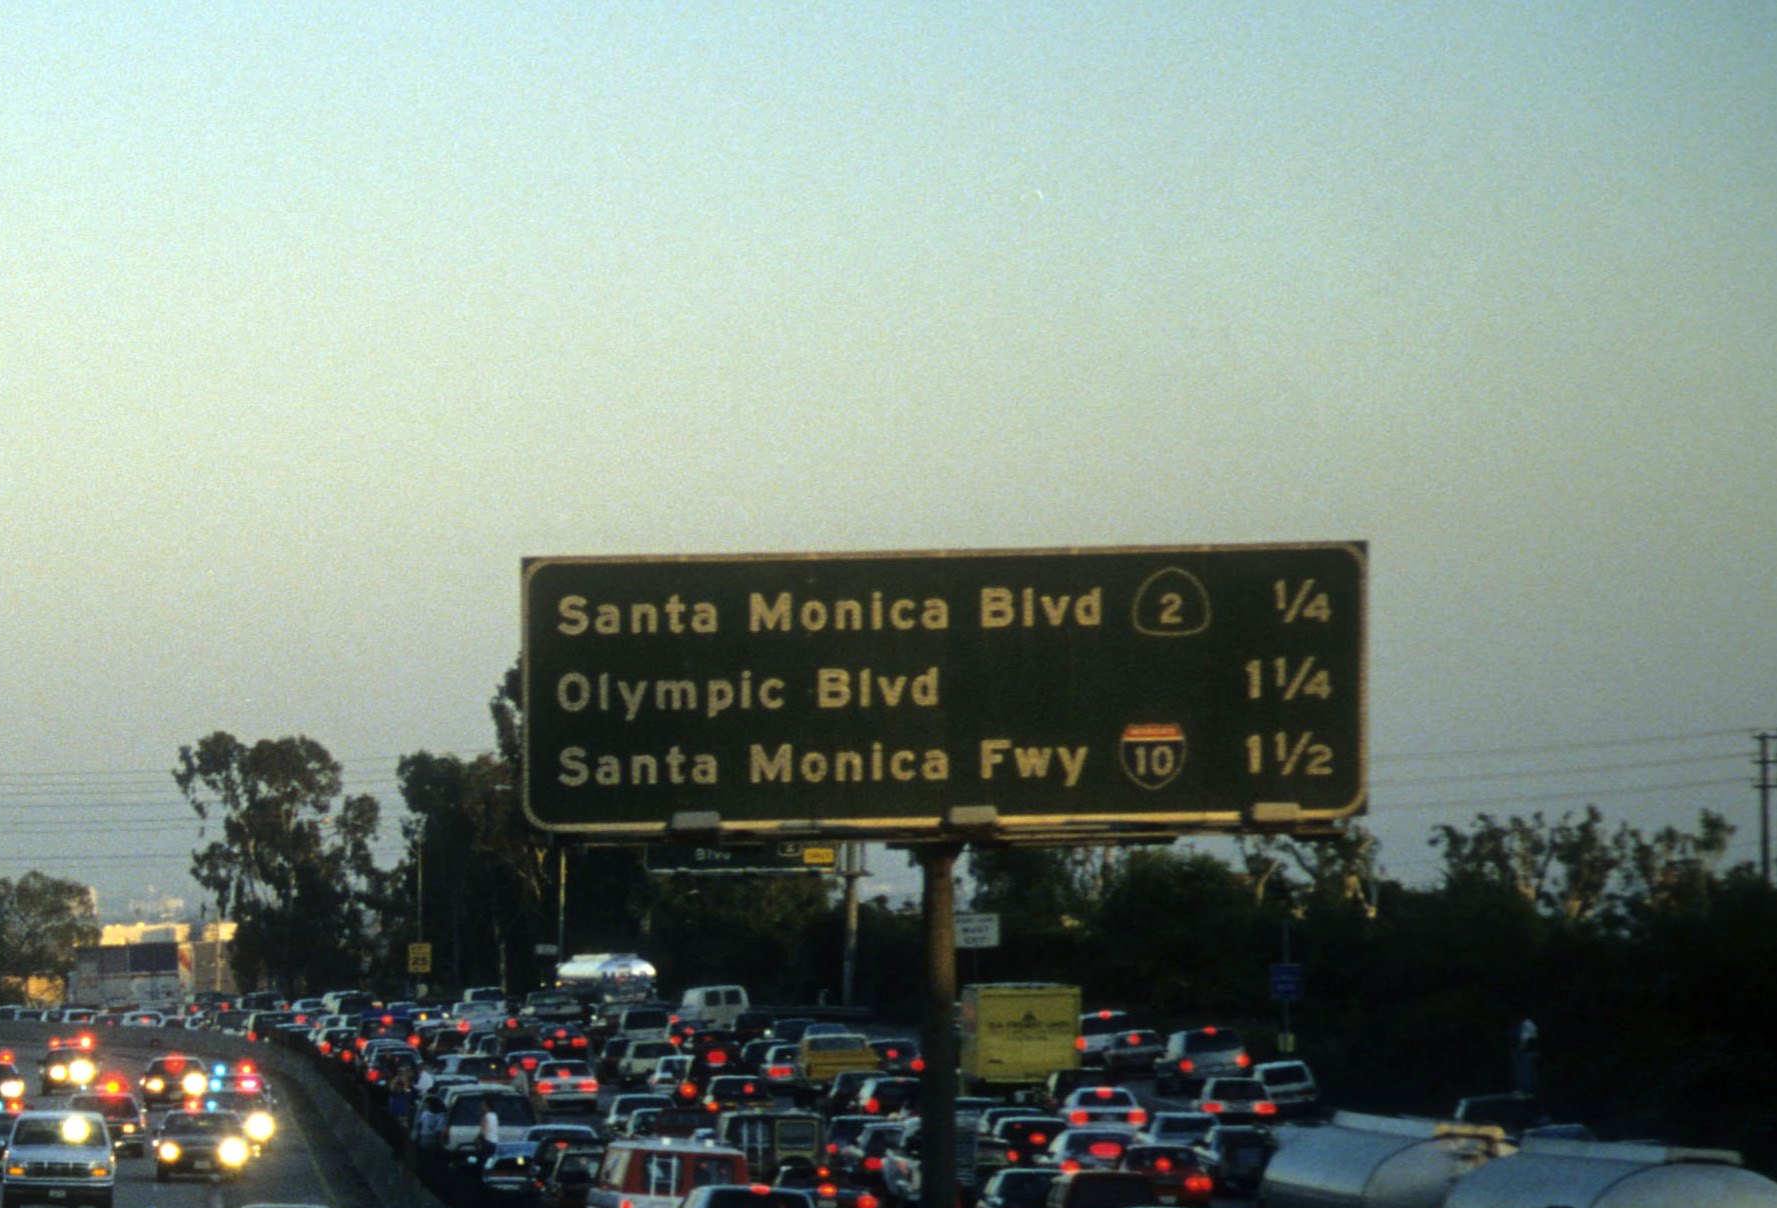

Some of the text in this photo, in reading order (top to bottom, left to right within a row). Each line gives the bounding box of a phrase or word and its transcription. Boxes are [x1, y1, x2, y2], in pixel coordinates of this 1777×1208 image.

[557, 594, 718, 636] Santa
[749, 590, 949, 633] Monica
[980, 587, 1102, 629] Blvd
[1159, 592, 1183, 625] 2
[557, 669, 786, 721] Olympic
[817, 666, 939, 709] Blvd
[558, 745, 718, 787] Santa
[750, 741, 949, 784] Monica
[980, 738, 1088, 787] Fwy
[1134, 746, 1174, 777] 10
